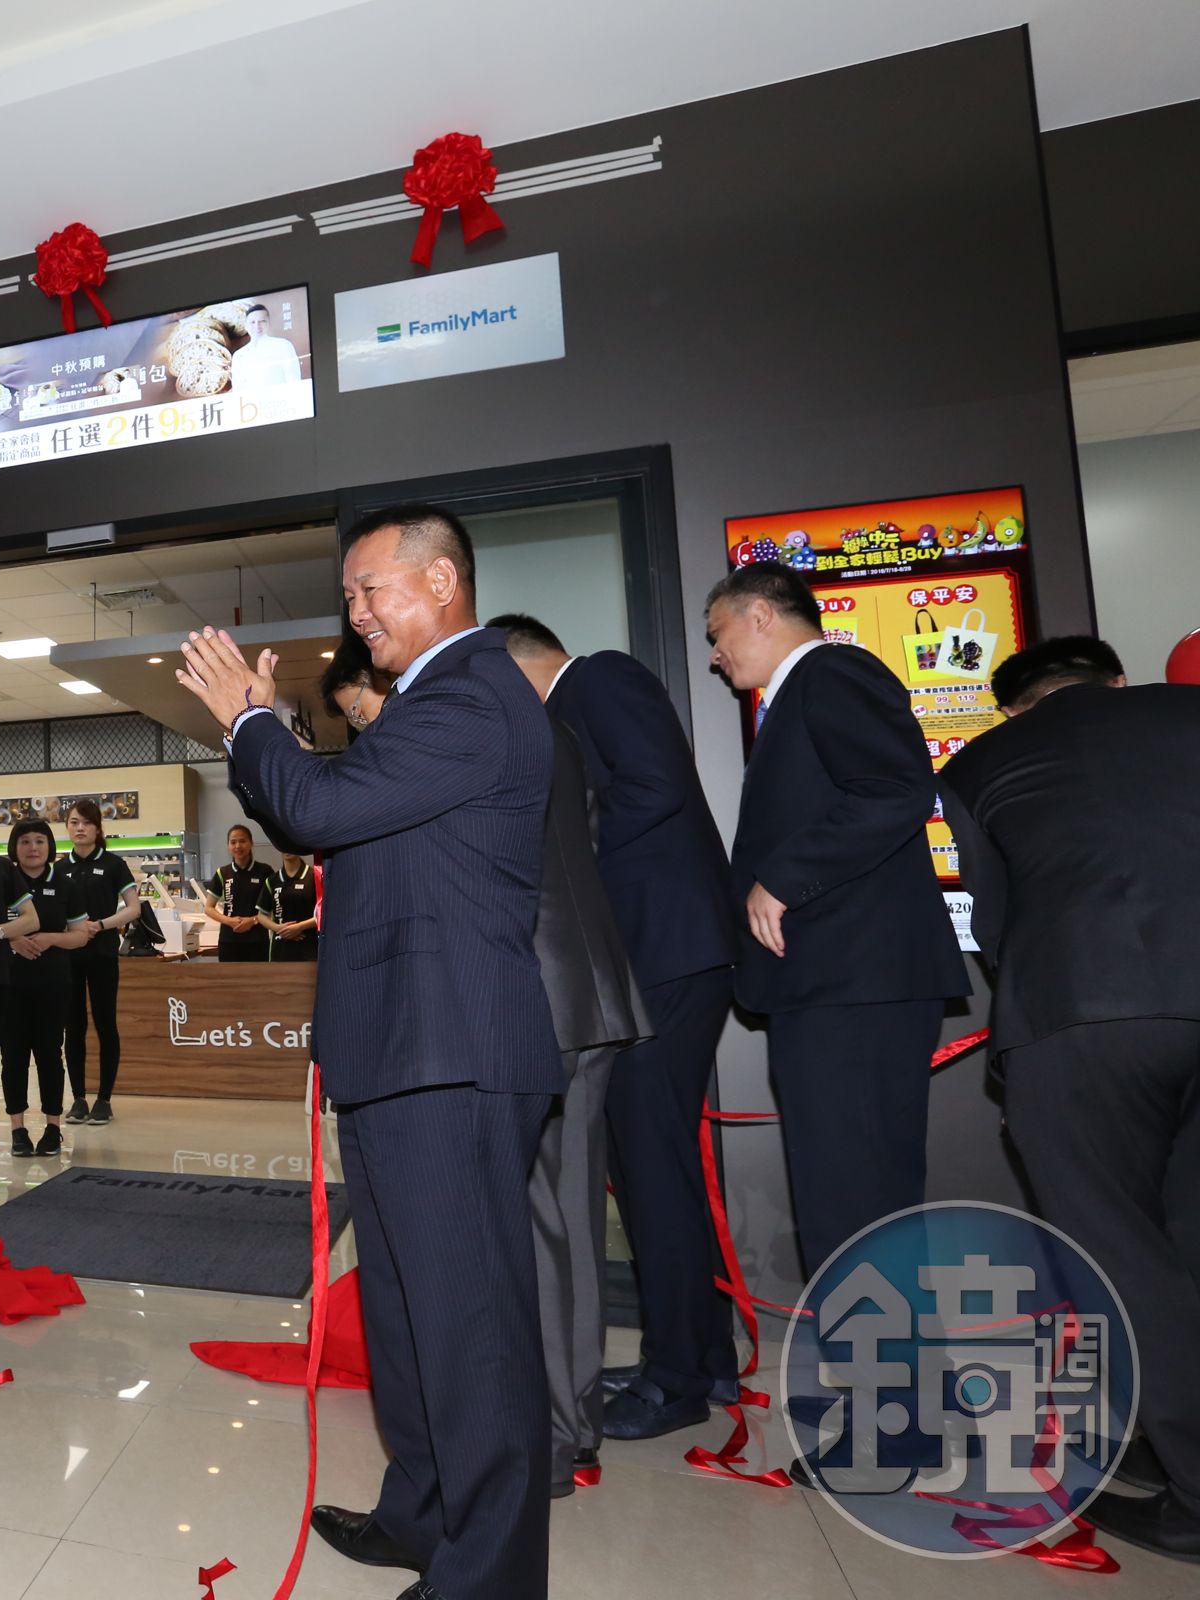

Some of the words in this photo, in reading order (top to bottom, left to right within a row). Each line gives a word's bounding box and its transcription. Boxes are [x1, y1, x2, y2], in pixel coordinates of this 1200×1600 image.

[409, 305, 517, 336] FamilyMart
[51, 355, 106, 376] 中秋預購
[909, 585, 975, 605] 保平安
